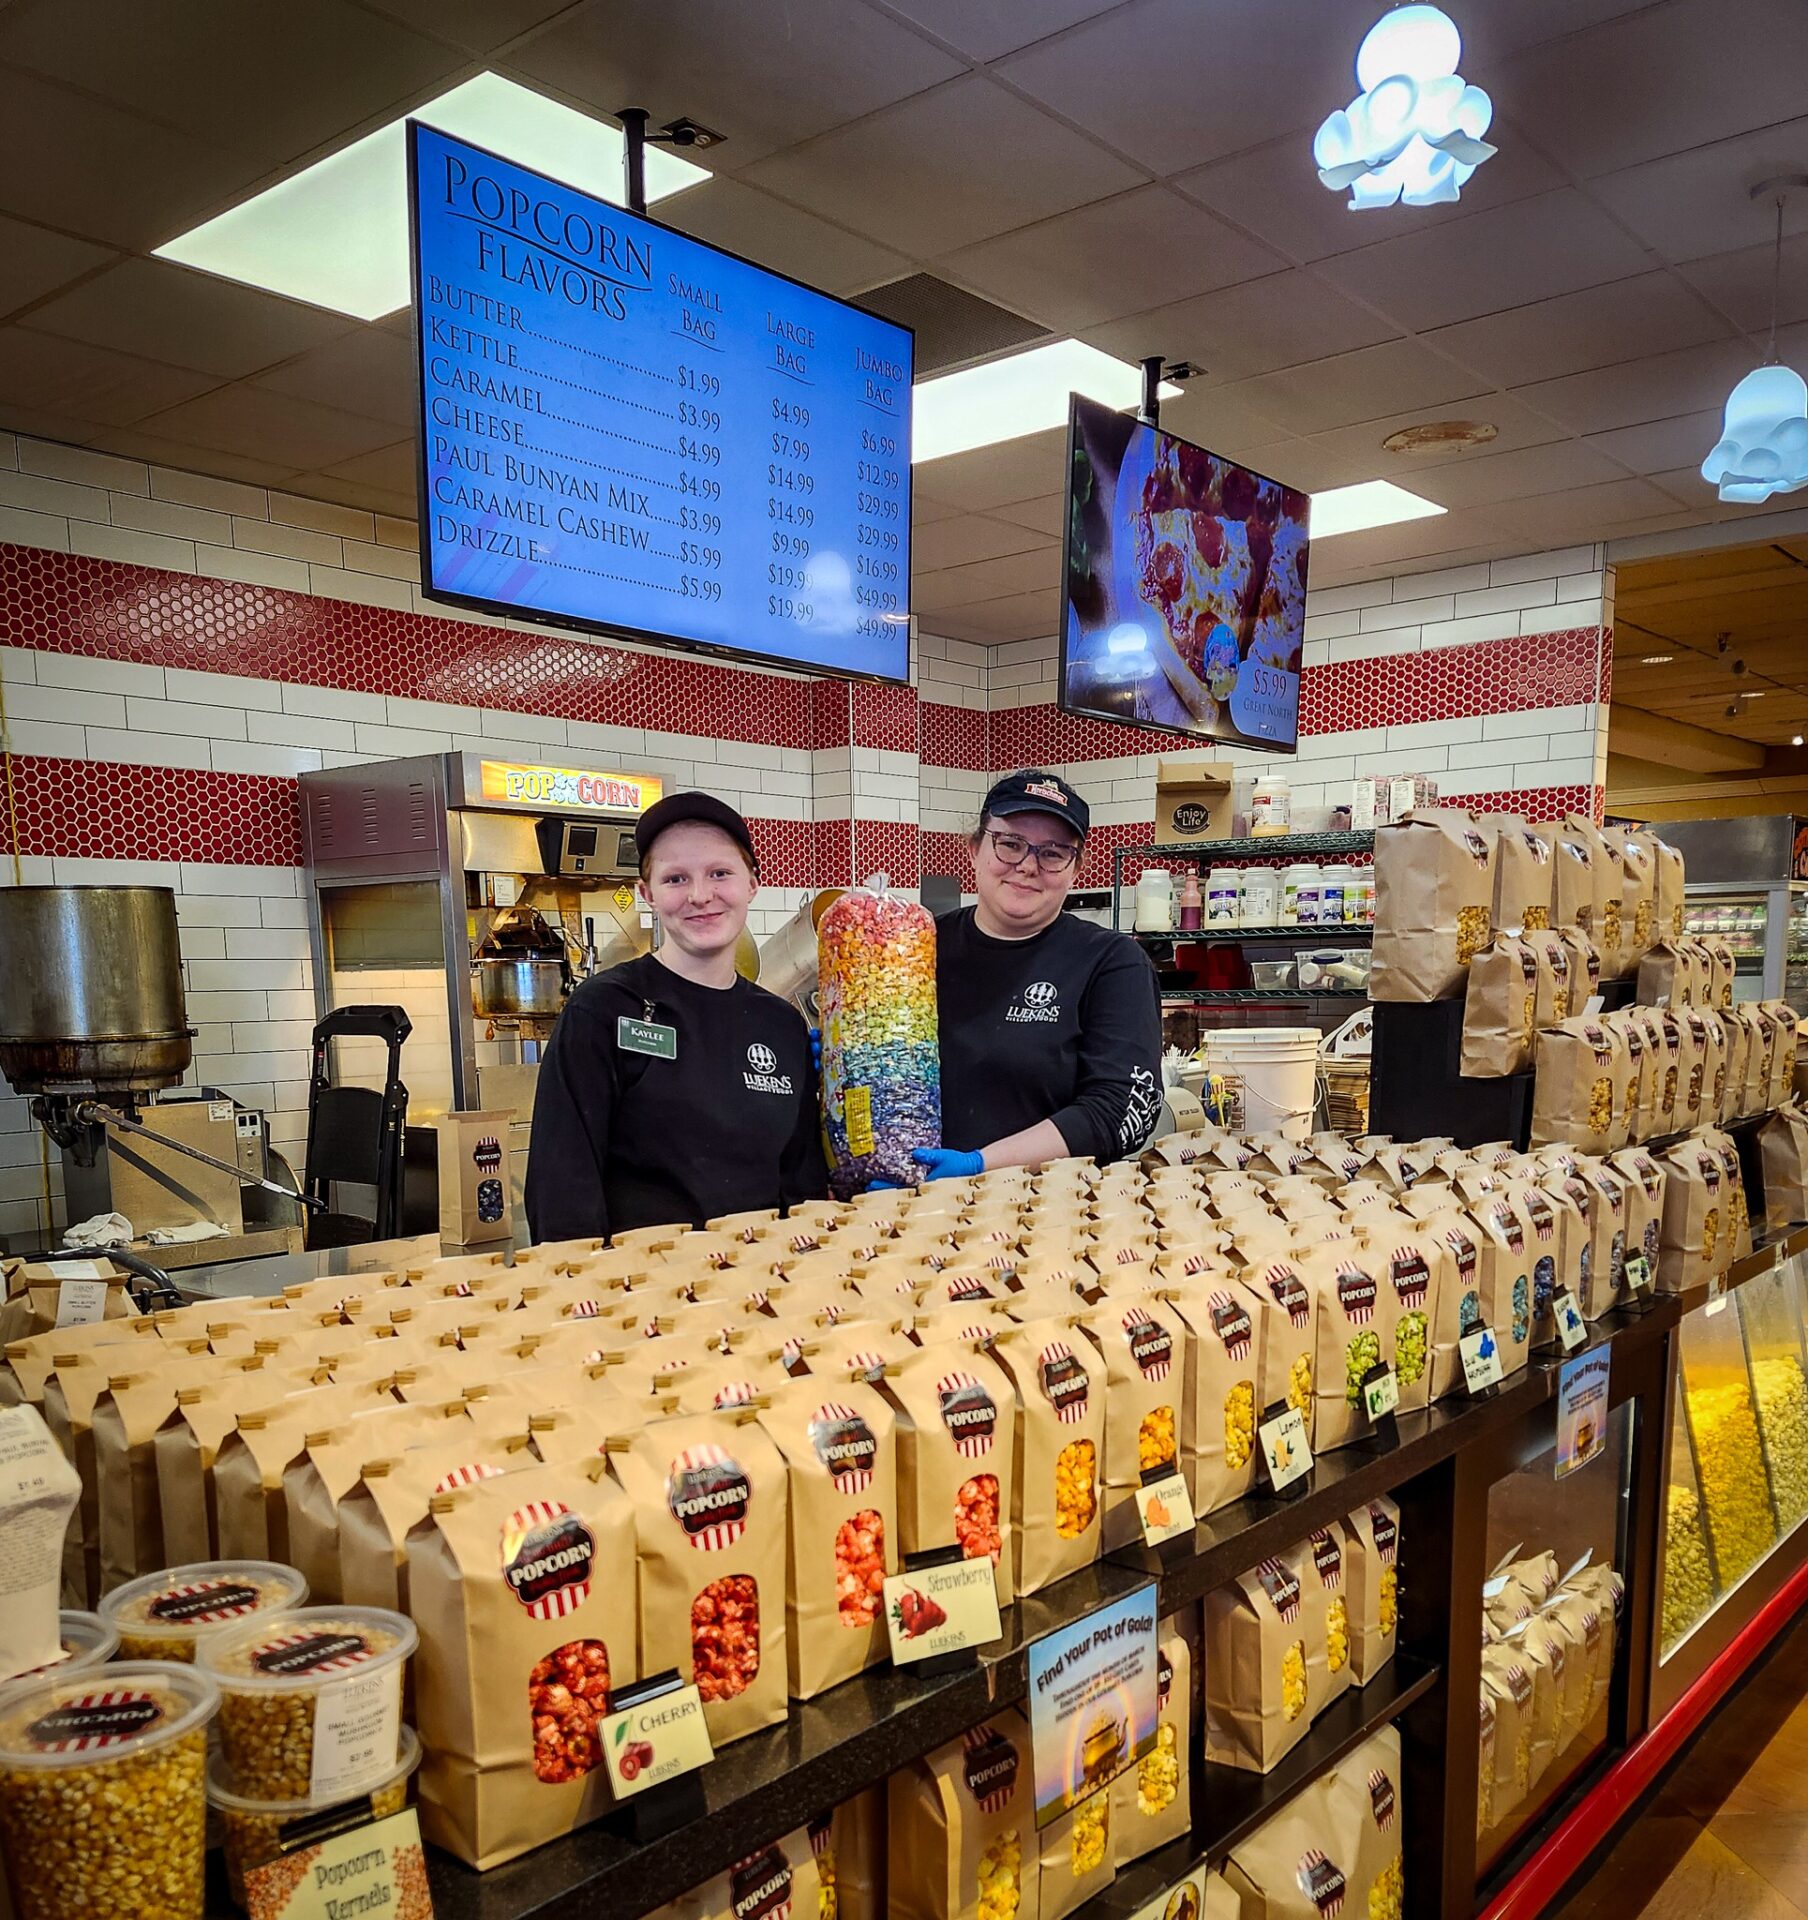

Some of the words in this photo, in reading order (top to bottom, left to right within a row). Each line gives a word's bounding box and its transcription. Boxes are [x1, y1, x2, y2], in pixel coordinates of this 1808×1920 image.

[443, 153, 651, 282] POPCORN
[477, 228, 626, 320] FLAVORS
[669, 273, 723, 313] SMALL
[682, 309, 716, 340] BAG
[767, 312, 815, 349] LARGE
[430, 274, 526, 334] BUTTER
[678, 365, 720, 398] $1.99
[772, 398, 810, 428] $4.99
[861, 429, 895, 457] $6.99
[776, 345, 806, 373] BAG
[855, 347, 903, 382] JUMBO
[430, 315, 518, 368] KETTLE
[679, 400, 720, 433] $3.99
[772, 431, 810, 462] $7.99
[857, 460, 899, 490] $12.99
[866, 379, 892, 405] BAG
[430, 357, 548, 415] CARAMEL
[679, 436, 721, 467] $4.99
[768, 463, 814, 495] $14.99
[857, 492, 899, 520] $29.99
[432, 397, 524, 447] CHEESE
[679, 471, 721, 502] $4.99
[768, 497, 814, 529] $14.99
[857, 523, 898, 552] $29.99
[434, 436, 494, 476] PAUL
[504, 455, 599, 503] BUNYAN
[608, 484, 650, 517] MIX
[680, 505, 721, 536] $3.99
[772, 530, 809, 559] $9.99
[856, 554, 898, 582] $16.99
[435, 476, 549, 528] CARAMEL
[558, 507, 650, 550] CASHEW
[680, 540, 721, 570] $5.99
[768, 563, 814, 592] $19.99
[856, 586, 897, 611] $49.99
[437, 515, 539, 562] DRIZZLE
[680, 574, 721, 603] $5.99
[768, 595, 814, 623] $19.99
[856, 616, 896, 641] $49.99
[1253, 669, 1287, 699] $5.99
[1243, 697, 1266, 713] GREAT
[1268, 704, 1292, 720] NORTH
[507, 772, 555, 800] POP
[577, 776, 640, 807] CORN
[1177, 808, 1206, 819] Enjoy
[1182, 817, 1200, 826] Life
[631, 1026, 665, 1042] KAYLEE
[1341, 1286, 1376, 1301] POPCORN
[1395, 1270, 1429, 1287] POPCORN
[1219, 1316, 1250, 1338] POPCORN
[1133, 1337, 1172, 1358] POPCORN
[1049, 1375, 1088, 1397] POPCORN
[947, 1406, 995, 1427] POPCORN
[821, 1439, 875, 1460] POPCORN
[677, 1485, 748, 1518] POPCORN
[511, 1541, 591, 1586] POPCORN
[928, 1567, 991, 1593] Strawberry
[159, 1591, 254, 1617] POPCORN
[269, 1637, 360, 1671] POPCORN
[1037, 1656, 1064, 1692] Find
[1064, 1637, 1091, 1665] Your
[1093, 1624, 1113, 1647] Pot
[1114, 1617, 1126, 1636] of
[1127, 1615, 1154, 1633] Gold!
[39, 1708, 153, 1728] POPCORN
[640, 1701, 698, 1732] CHERRY
[969, 1755, 1016, 1788] POPCORN
[314, 1848, 386, 1889] Popcorn
[325, 1882, 391, 1919] Kernels
[735, 1869, 791, 1917] POPCORN
[1311, 1873, 1345, 1900] POPCORN
